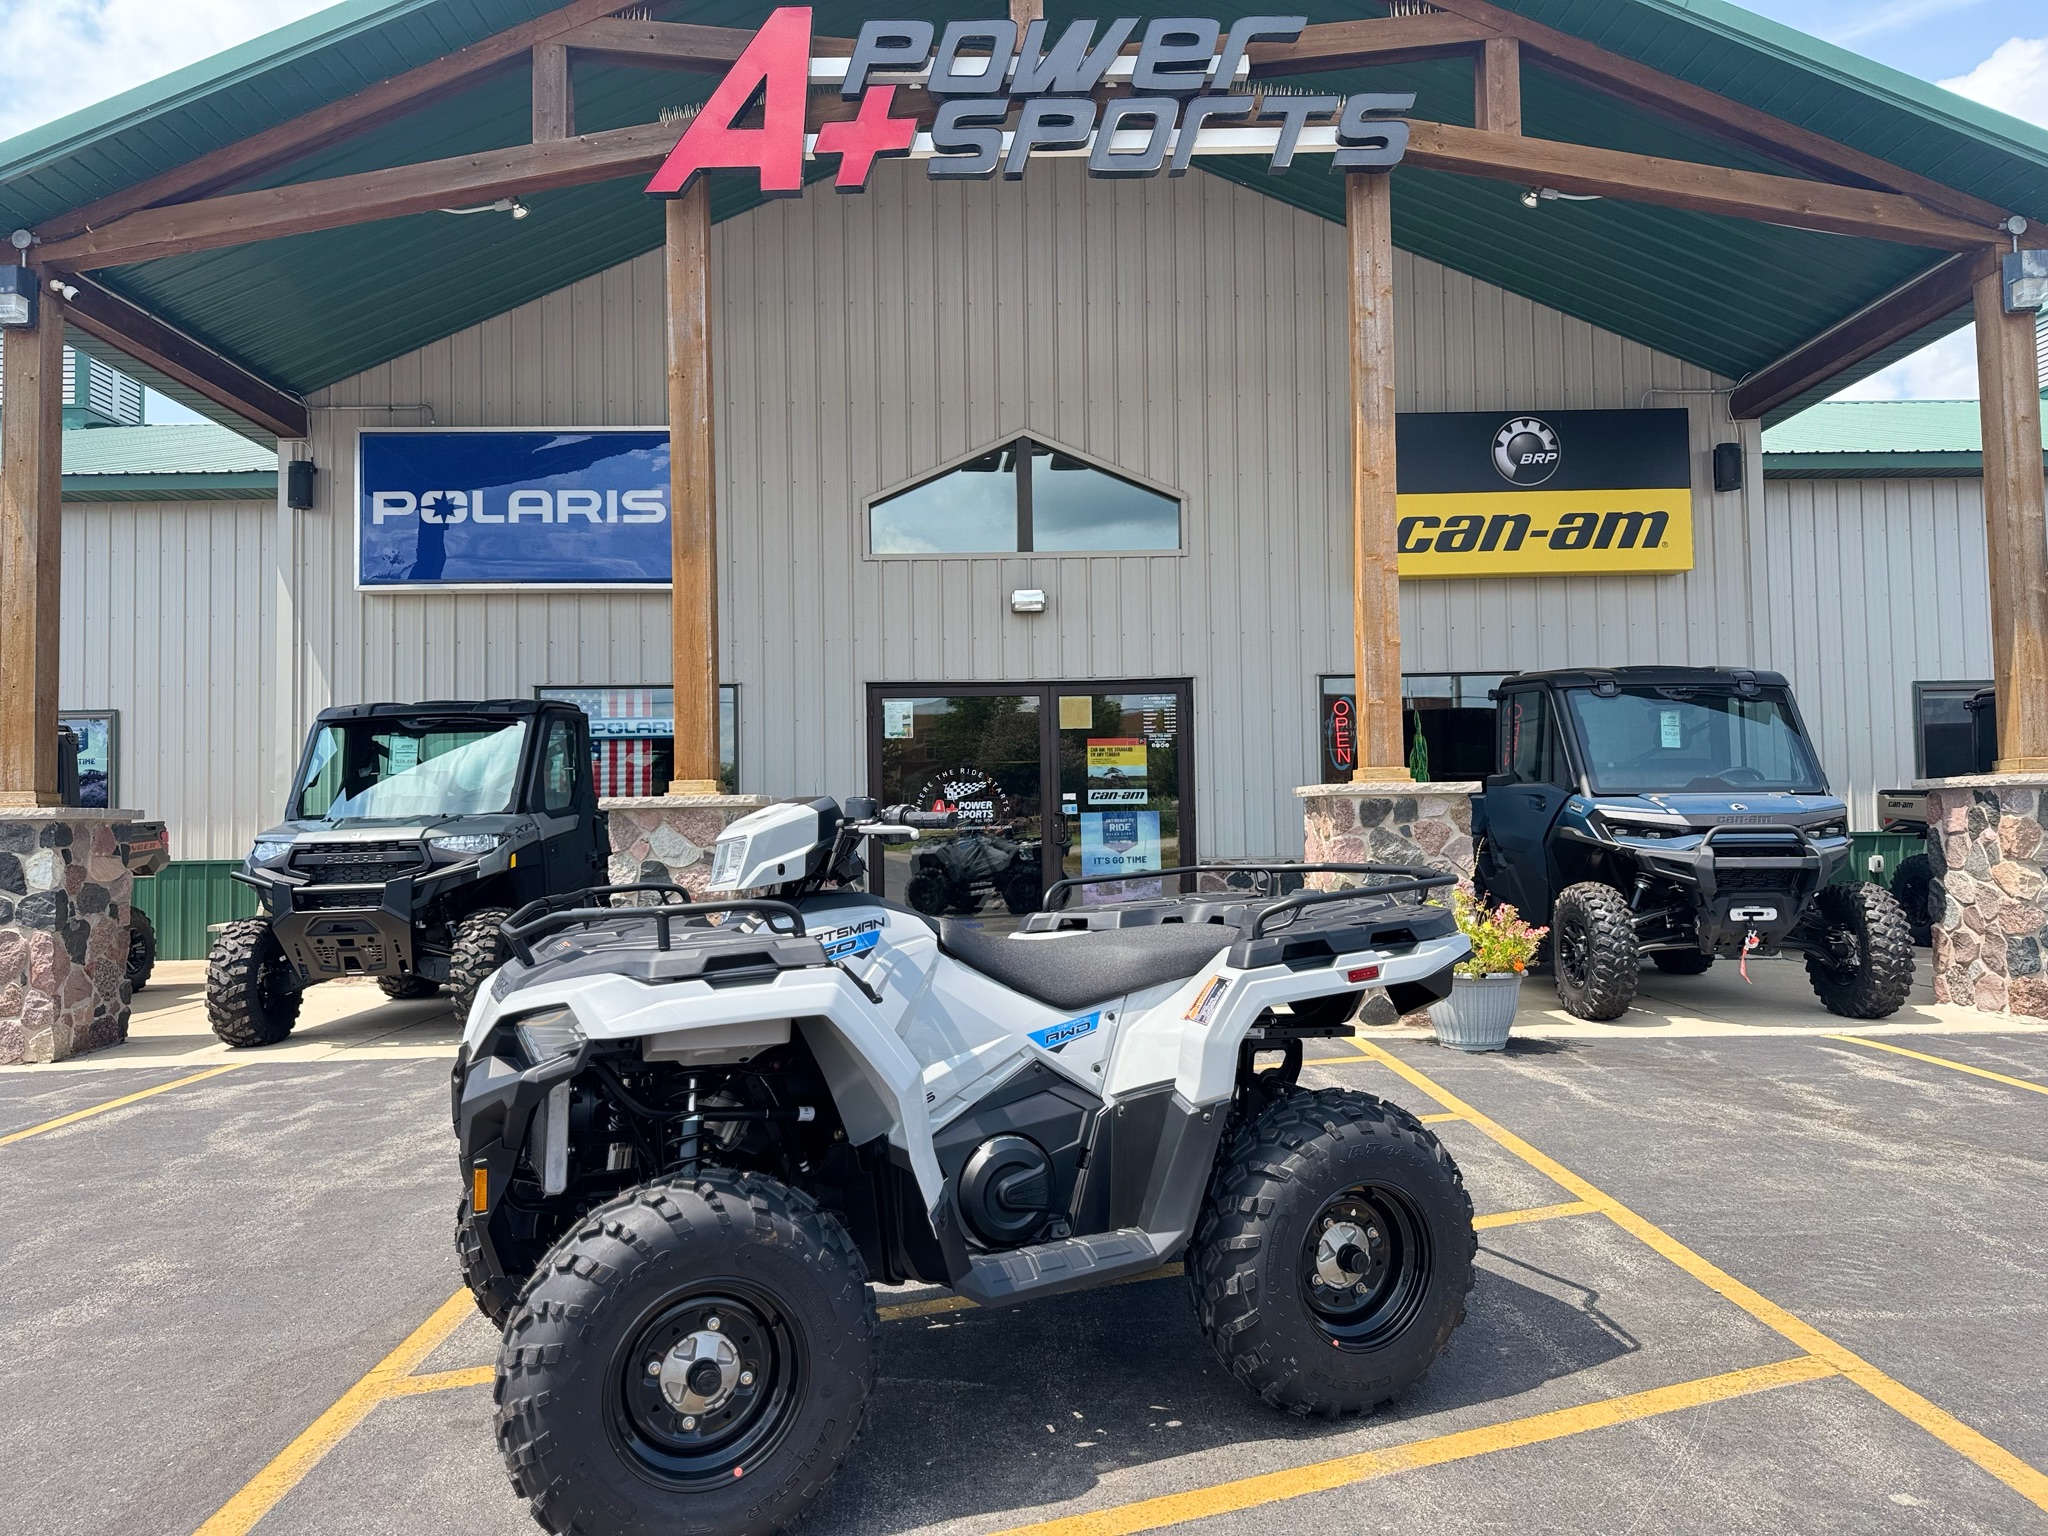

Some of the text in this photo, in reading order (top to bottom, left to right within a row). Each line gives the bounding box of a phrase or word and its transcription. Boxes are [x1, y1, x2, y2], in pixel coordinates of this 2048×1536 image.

[1520, 452, 1558, 464] BRP
[372, 489, 667, 525] POLARIS
[591, 721, 673, 734] POLARI
[1333, 700, 1351, 763] OPEN
[936, 769, 955, 780] THE
[960, 767, 984, 778] RIDE
[986, 777, 1010, 812] STARTS
[1091, 791, 1145, 800] can-am
[958, 800, 993, 810] POWER
[957, 809, 994, 819] SPORTS
[515, 823, 533, 834] XP
[1109, 823, 1131, 832] RIDE
[131, 843, 156, 851] NGER
[325, 854, 384, 864] POLARIS
[1112, 856, 1125, 864] GO
[1126, 855, 1148, 863] TIME
[1045, 1021, 1091, 1045] AWD
[746, 1416, 837, 1520] CARLSTAR
